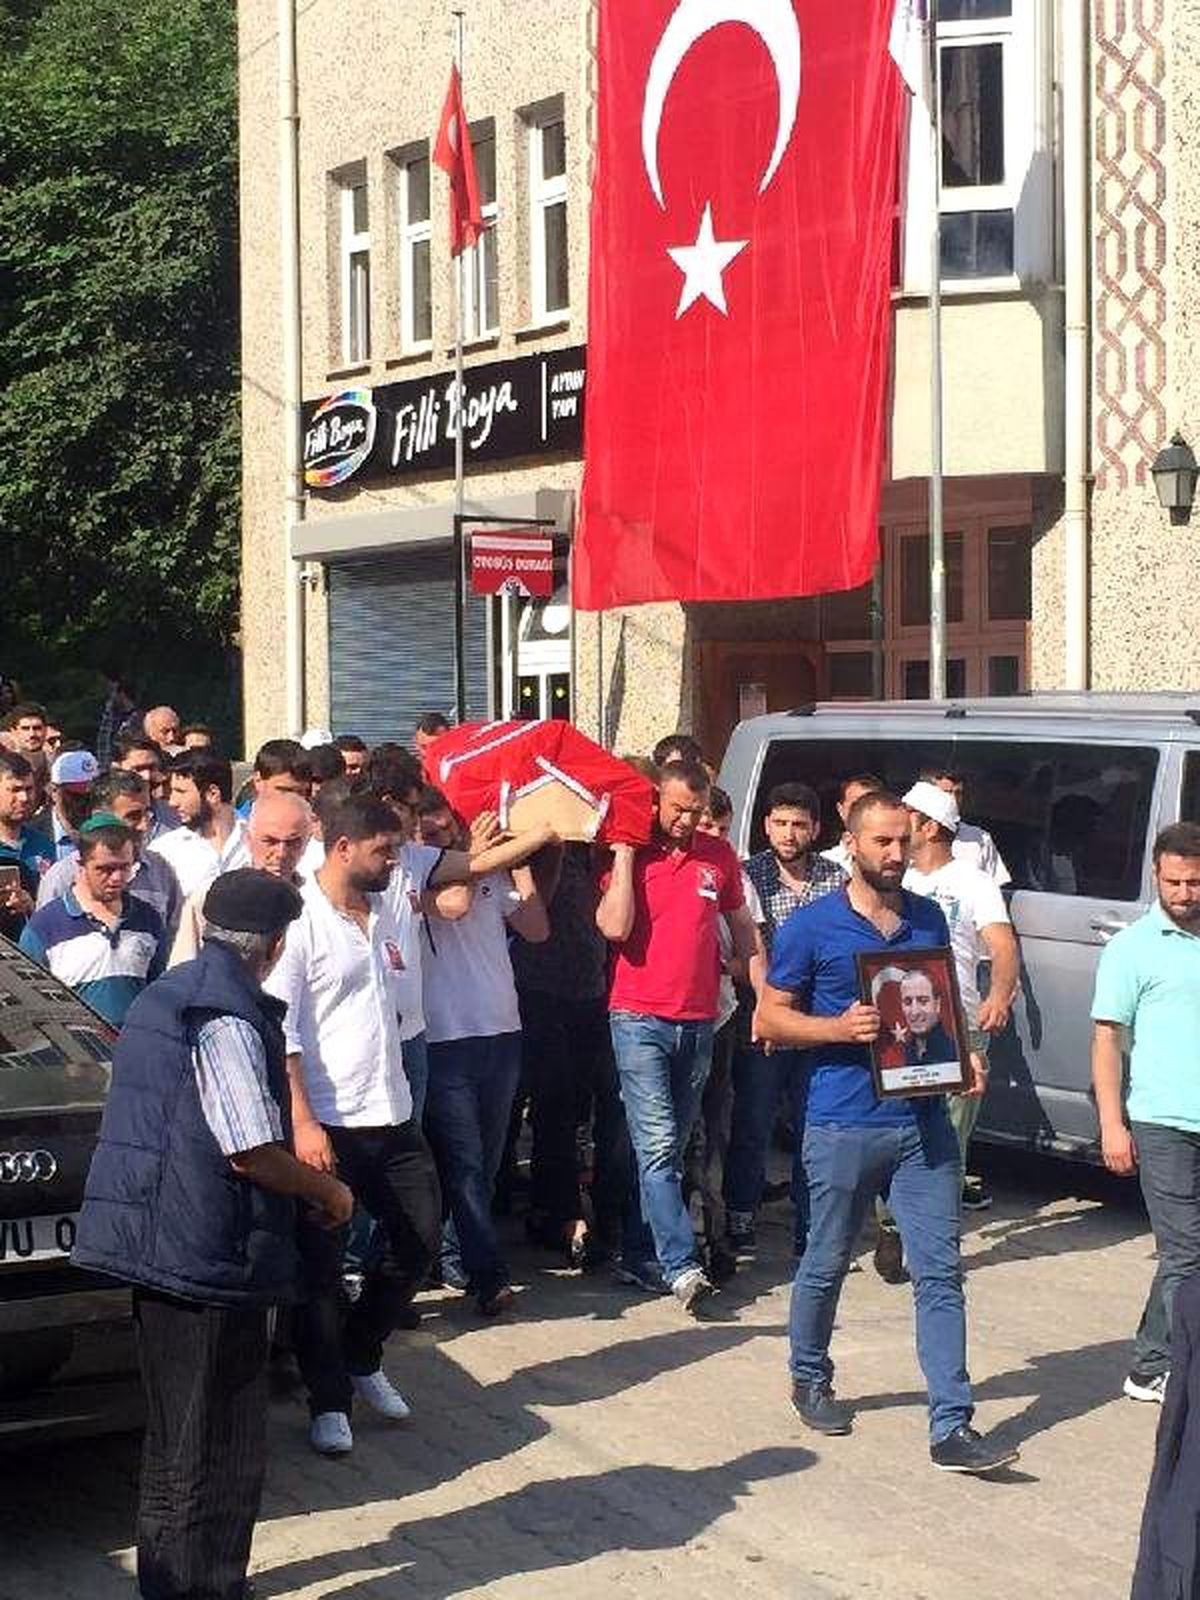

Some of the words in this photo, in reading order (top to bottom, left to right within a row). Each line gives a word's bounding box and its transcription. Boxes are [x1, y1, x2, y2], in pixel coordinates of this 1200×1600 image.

[303, 420, 331, 460] Filli
[328, 416, 366, 451] Boya
[391, 388, 441, 467] Filli
[445, 380, 518, 450] Boya
